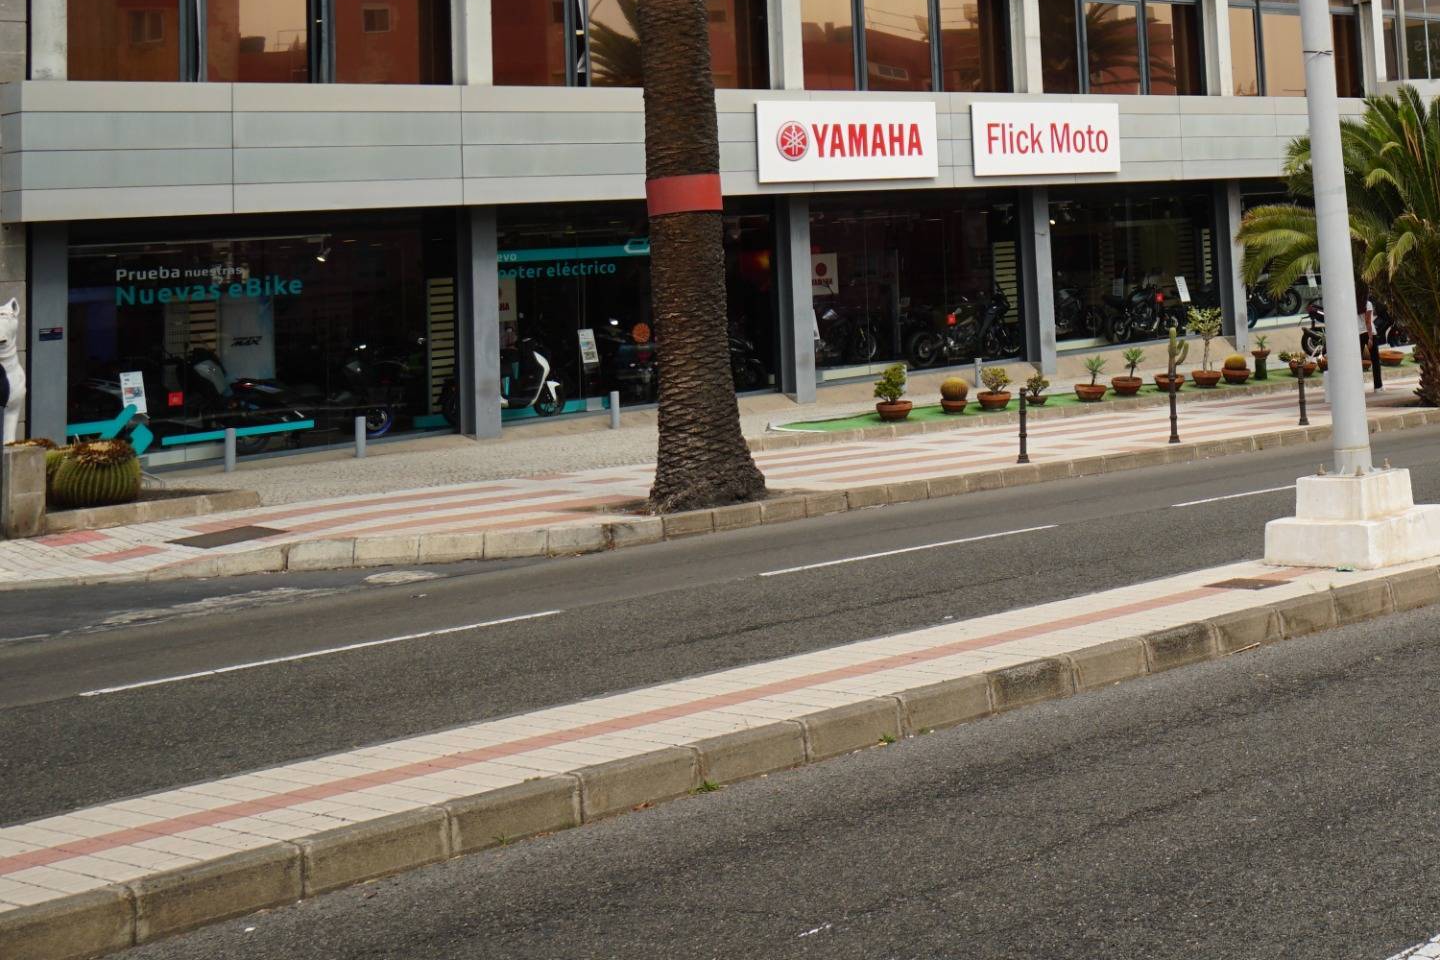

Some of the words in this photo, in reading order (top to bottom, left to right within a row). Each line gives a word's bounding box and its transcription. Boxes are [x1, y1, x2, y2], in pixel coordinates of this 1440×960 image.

[811, 123, 923, 158] YAMAHA
[987, 122, 1043, 155] Flick
[1049, 122, 1109, 154] Moto
[115, 266, 181, 282] Prueba
[546, 261, 617, 278] eléctrico
[115, 283, 222, 306] Nuevas
[228, 274, 304, 298] eBike
